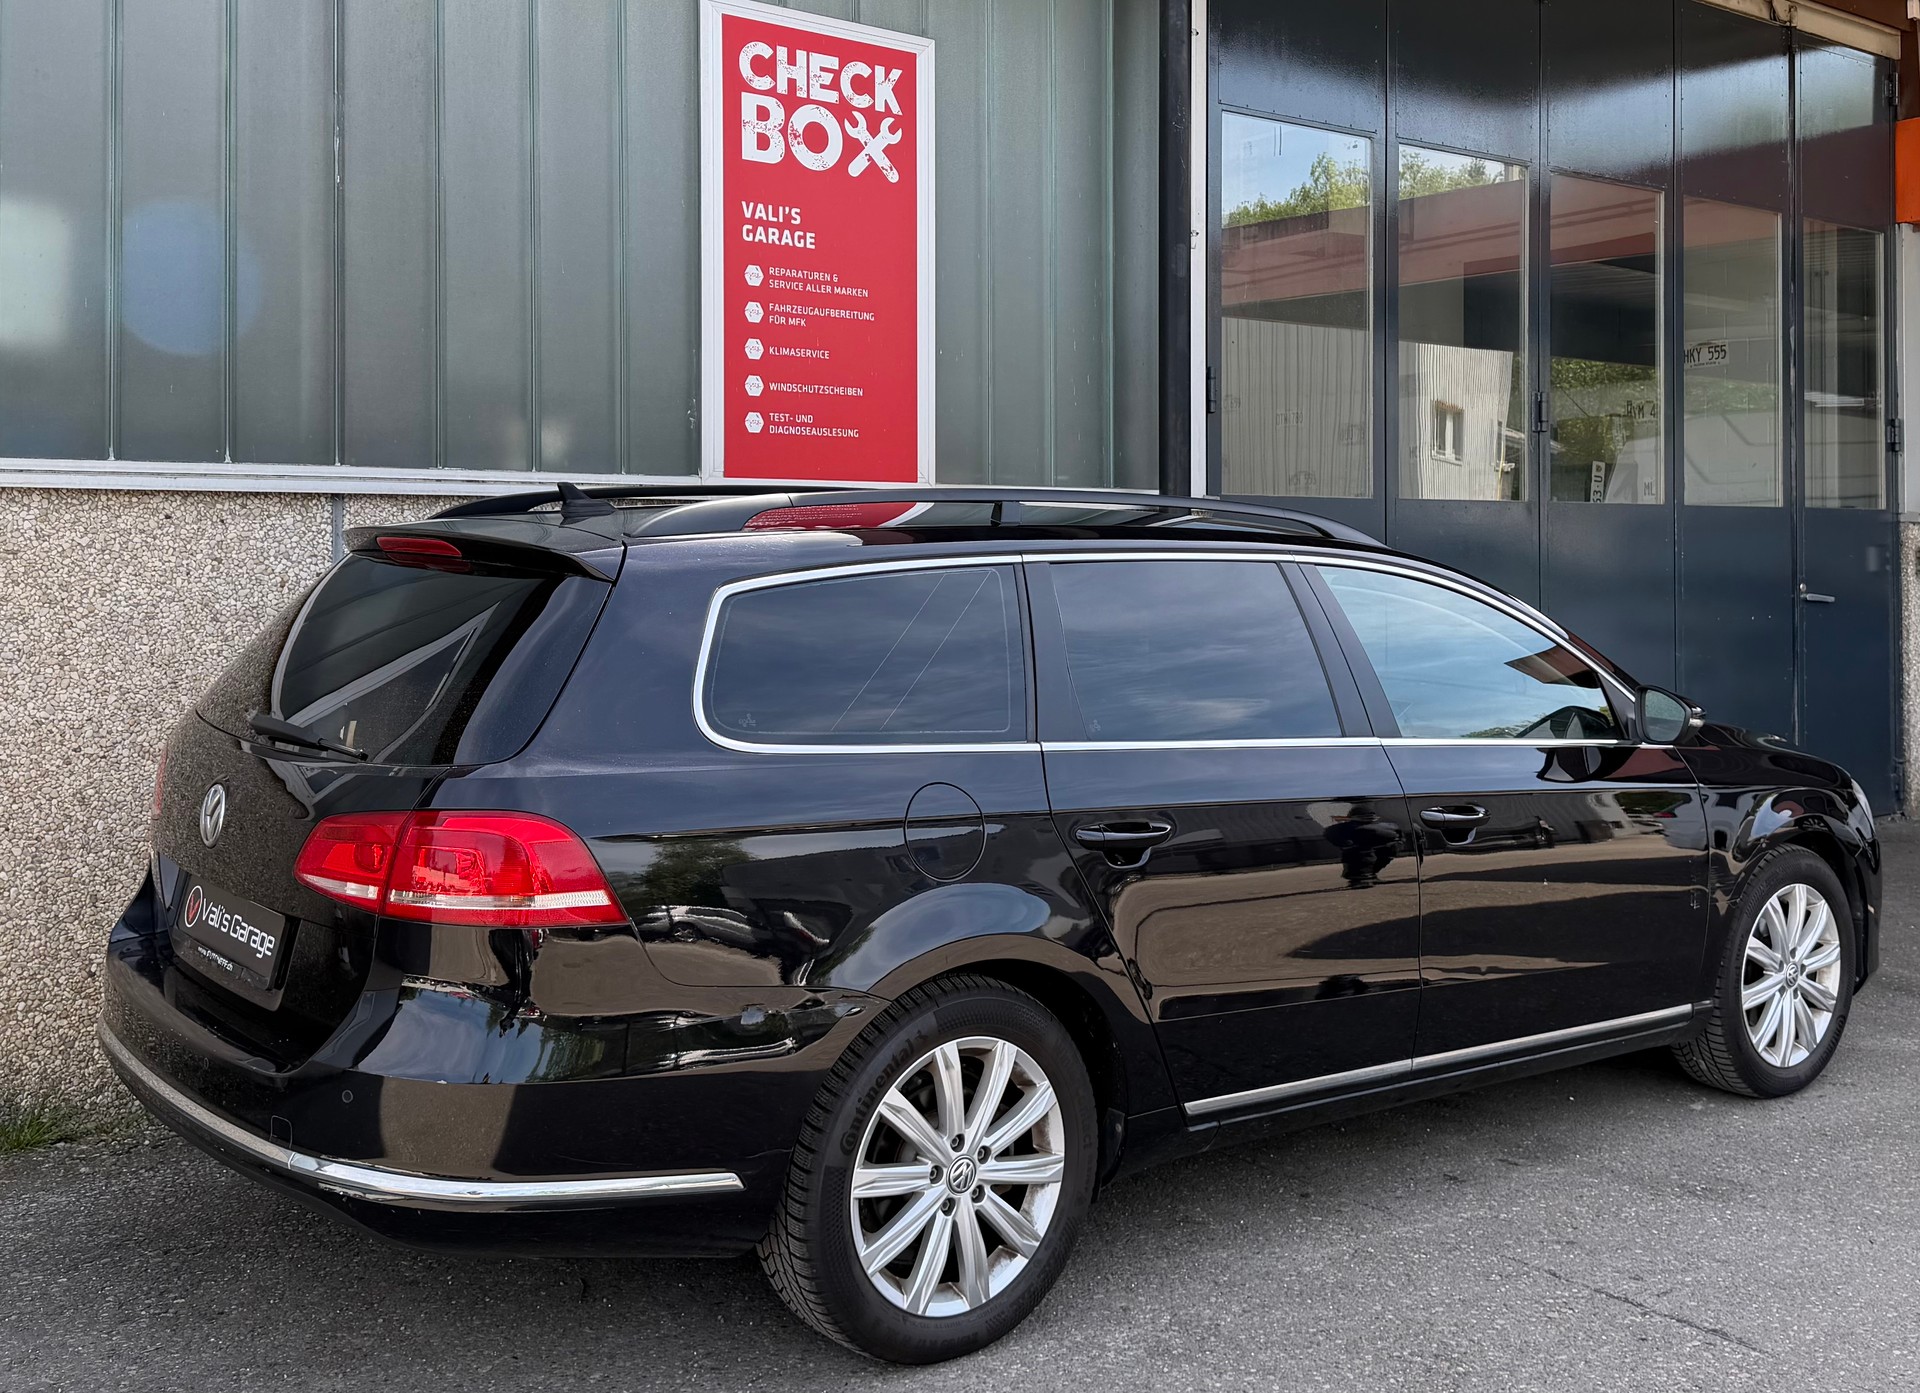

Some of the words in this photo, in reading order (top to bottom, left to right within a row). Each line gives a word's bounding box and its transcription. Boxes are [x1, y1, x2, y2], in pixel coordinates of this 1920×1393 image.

[739, 41, 903, 116] CHECK
[741, 200, 801, 225] VALI'S
[742, 224, 816, 249] GARAGE
[769, 266, 831, 282] REPARATUREN
[833, 274, 839, 283] &
[769, 279, 804, 291] SERVICE
[806, 283, 832, 294] ALLER
[834, 286, 869, 298] MARKEN
[769, 303, 875, 321] FAHRZEUGAUFBEREITUNG
[769, 315, 786, 326] FÜR
[788, 317, 807, 327] MFK
[769, 346, 830, 360] KLIMASERVICE
[1683, 347, 1702, 364] HKY
[1707, 344, 1727, 361] 555
[769, 382, 864, 397] WINDSCHUTZSCHEIBEN
[769, 412, 794, 423] TEST-
[795, 414, 814, 424] UND
[769, 425, 859, 438] DIAGNOSEAUSLESUNG
[202, 898, 231, 933] Vali's
[229, 914, 276, 959] Garage
